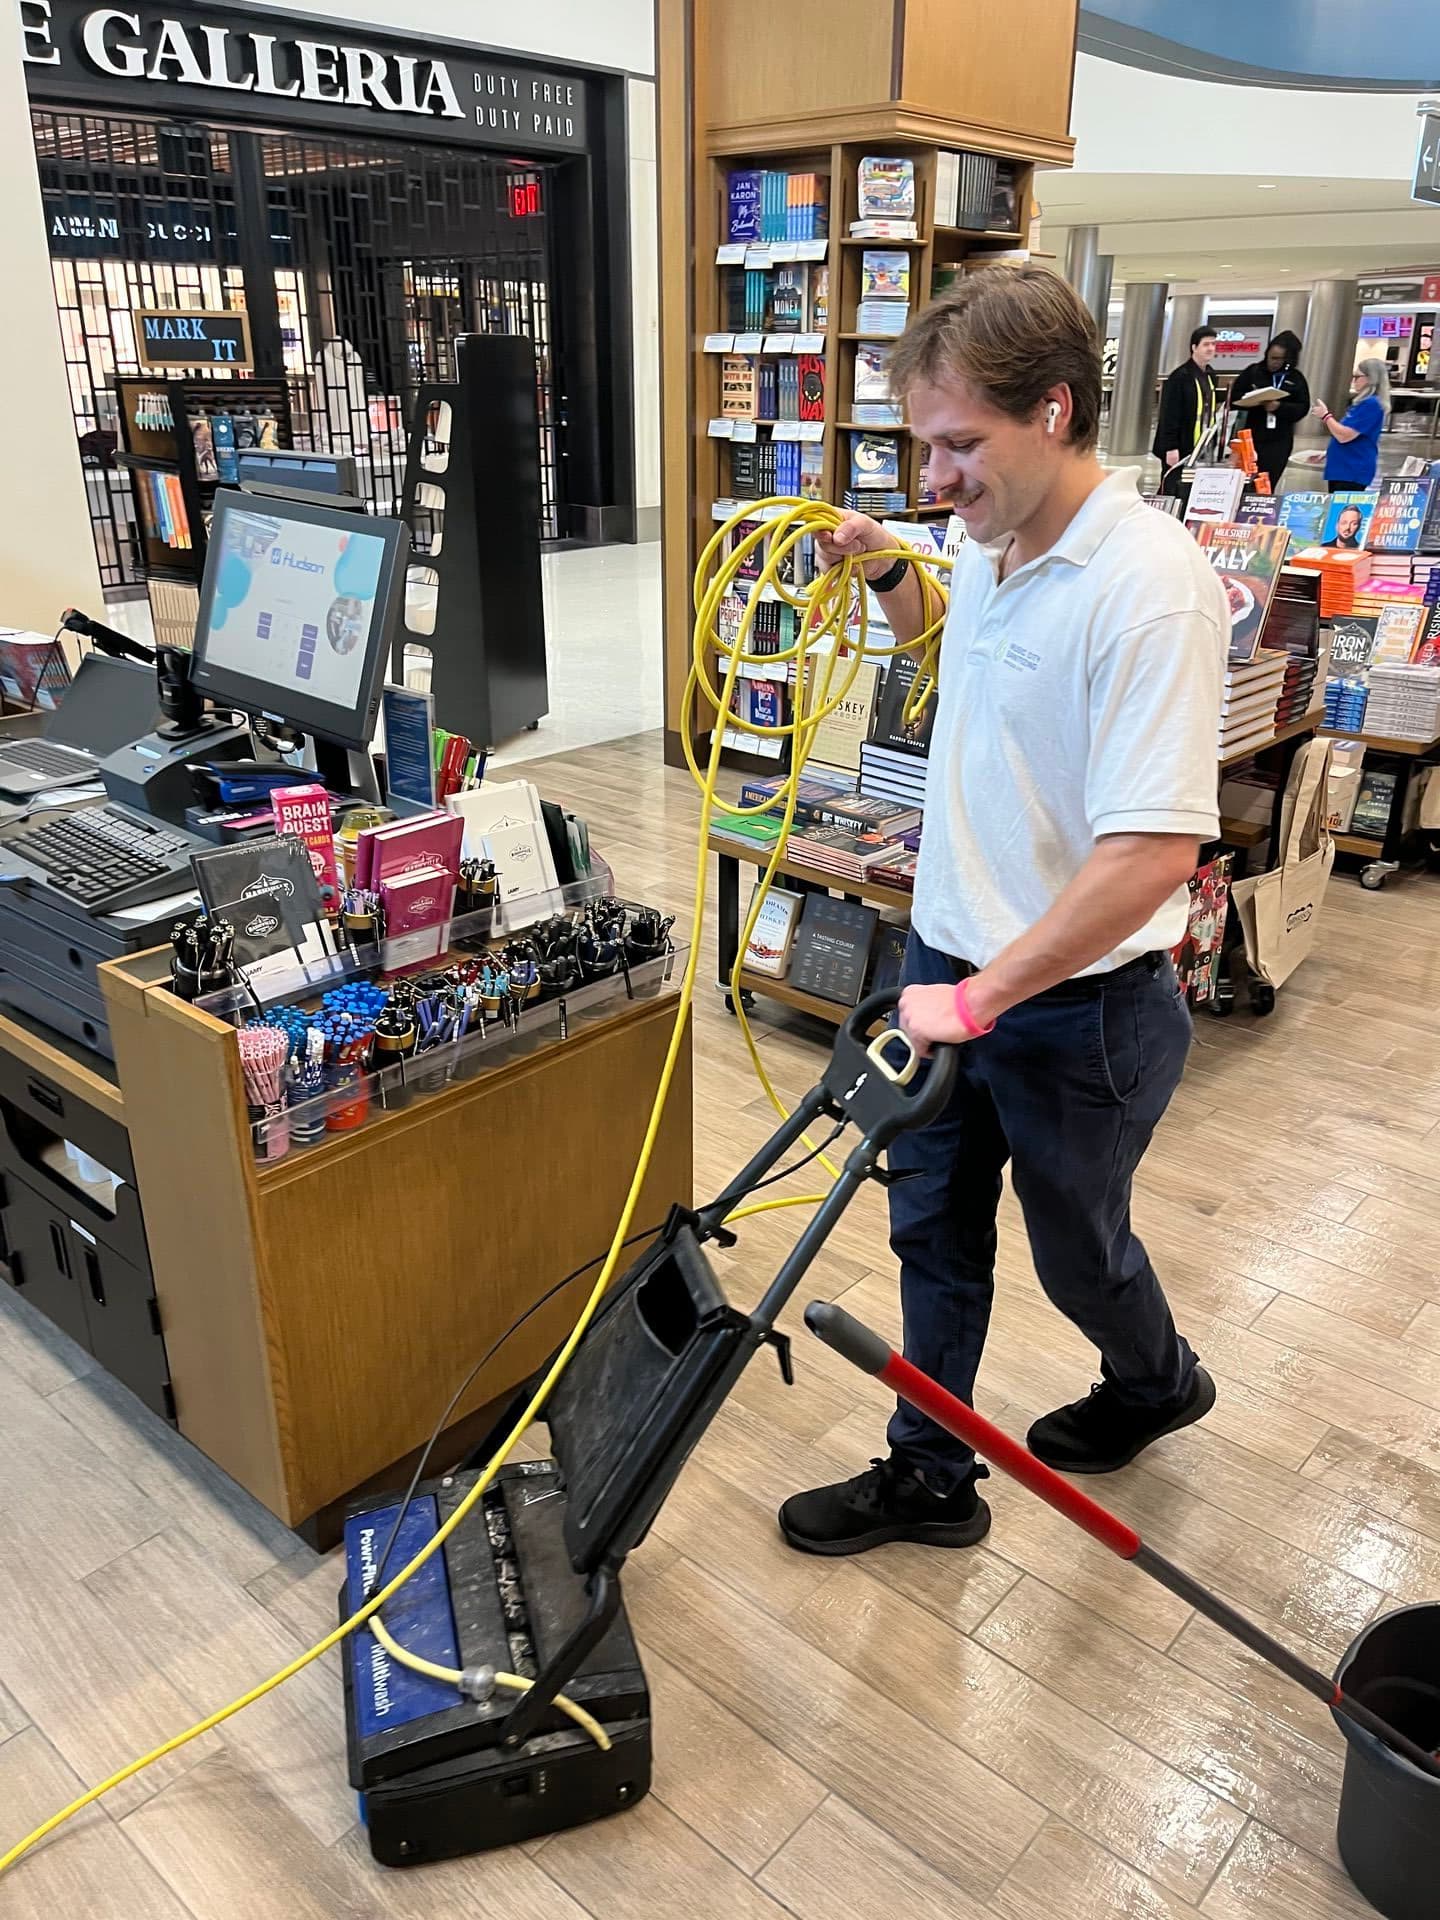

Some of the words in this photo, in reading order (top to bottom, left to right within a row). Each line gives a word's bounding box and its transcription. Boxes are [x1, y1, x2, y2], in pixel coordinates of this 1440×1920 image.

[83, 9, 466, 119] GALLERIA
[474, 72, 518, 98] DUTY
[532, 81, 574, 106] FREE
[475, 105, 520, 131] DUTY
[533, 113, 574, 137] PAID
[778, 270, 794, 291] OLD
[774, 300, 799, 315] MONEY
[144, 317, 208, 341] MARK
[211, 339, 237, 361] IT
[1389, 482, 1401, 494] TO
[1403, 482, 1419, 494] THE
[1389, 495, 1414, 506] MOON
[1379, 507, 1394, 519] AND
[1395, 507, 1420, 519] BACK
[1380, 522, 1409, 535] ELIANA
[283, 551, 325, 574] Hudson
[1333, 634, 1366, 650] IRON
[282, 801, 327, 821] BRAIN
[283, 816, 330, 835] QUEST
[834, 813, 863, 834] WHISKEY
[309, 834, 331, 847] CARDS
[370, 1642, 396, 1717] Multiwash
